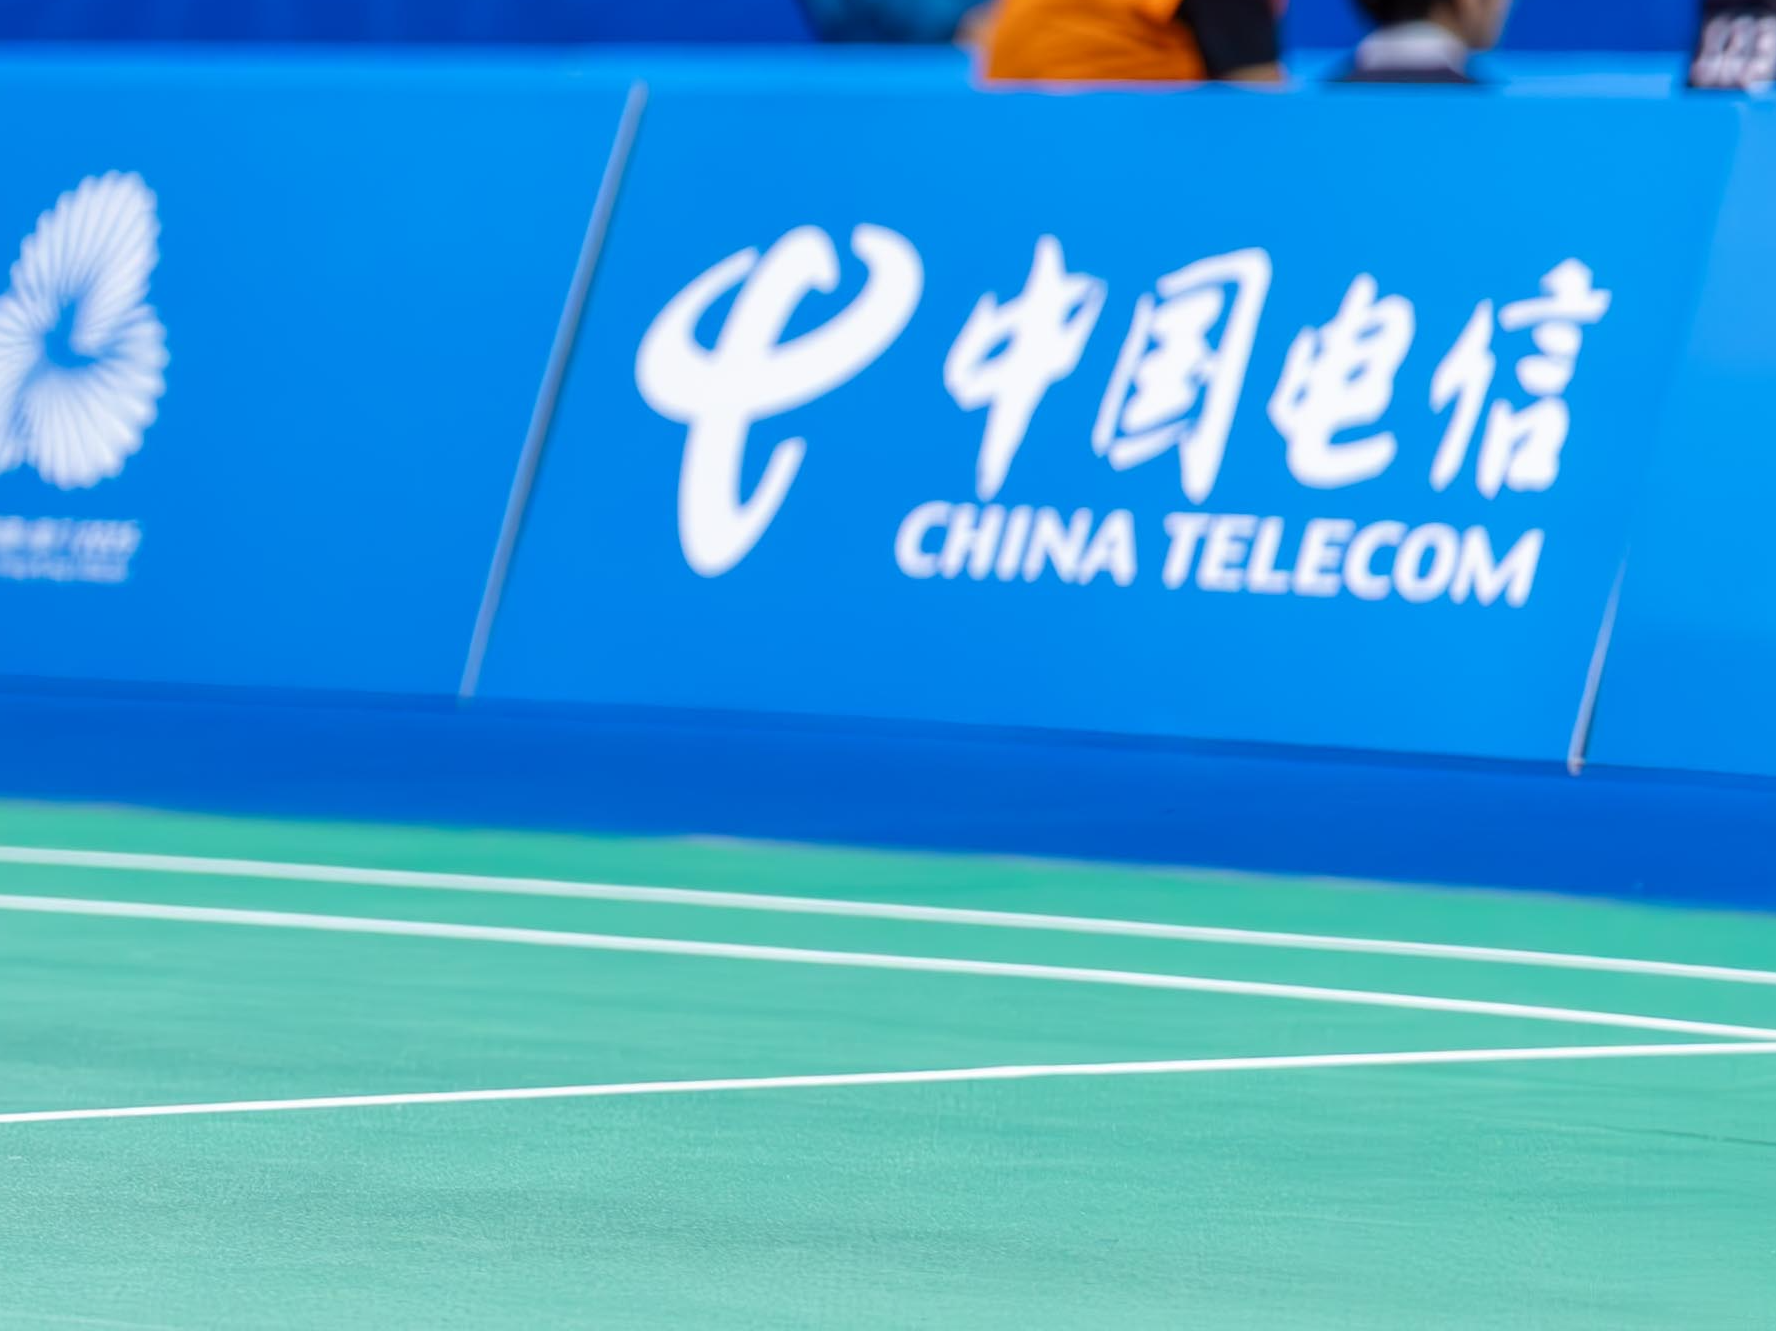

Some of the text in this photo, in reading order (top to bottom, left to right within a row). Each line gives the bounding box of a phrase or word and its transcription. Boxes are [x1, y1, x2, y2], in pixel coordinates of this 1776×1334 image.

[944, 233, 1612, 505] 中国电信
[893, 499, 1545, 608] CHINA TELECOM
